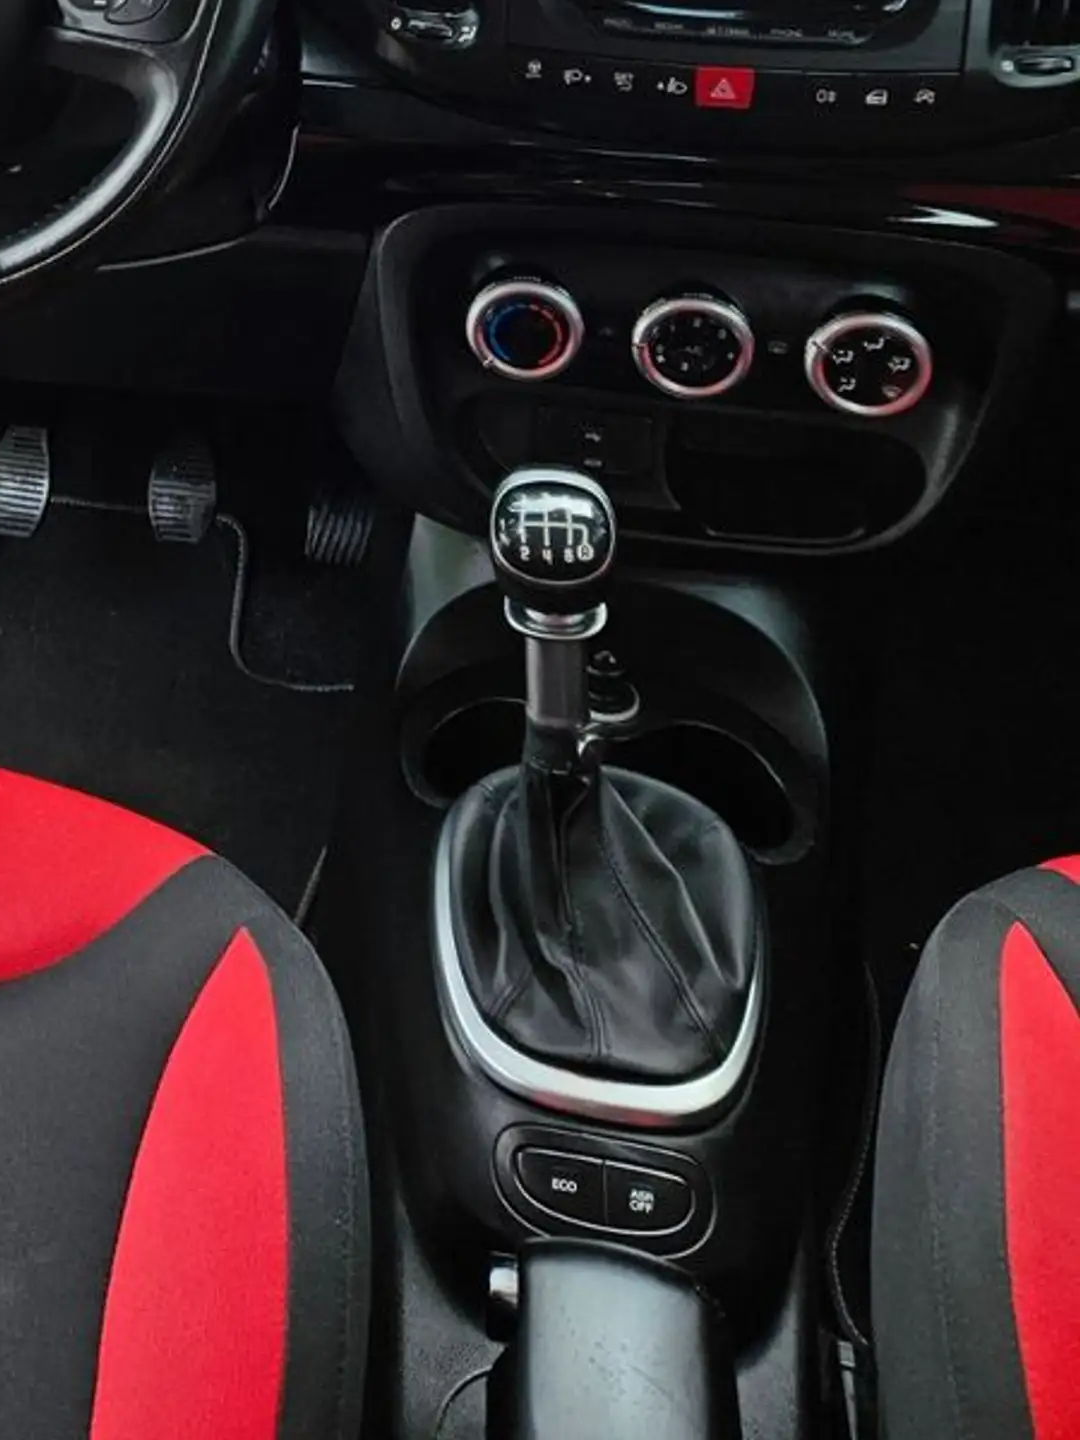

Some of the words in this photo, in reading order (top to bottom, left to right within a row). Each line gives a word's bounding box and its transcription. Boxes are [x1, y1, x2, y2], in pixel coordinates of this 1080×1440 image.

[519, 546, 531, 561] 2
[542, 549, 554, 565] 4
[552, 1178, 578, 1194] ECO
[629, 1200, 654, 1214] OFF
